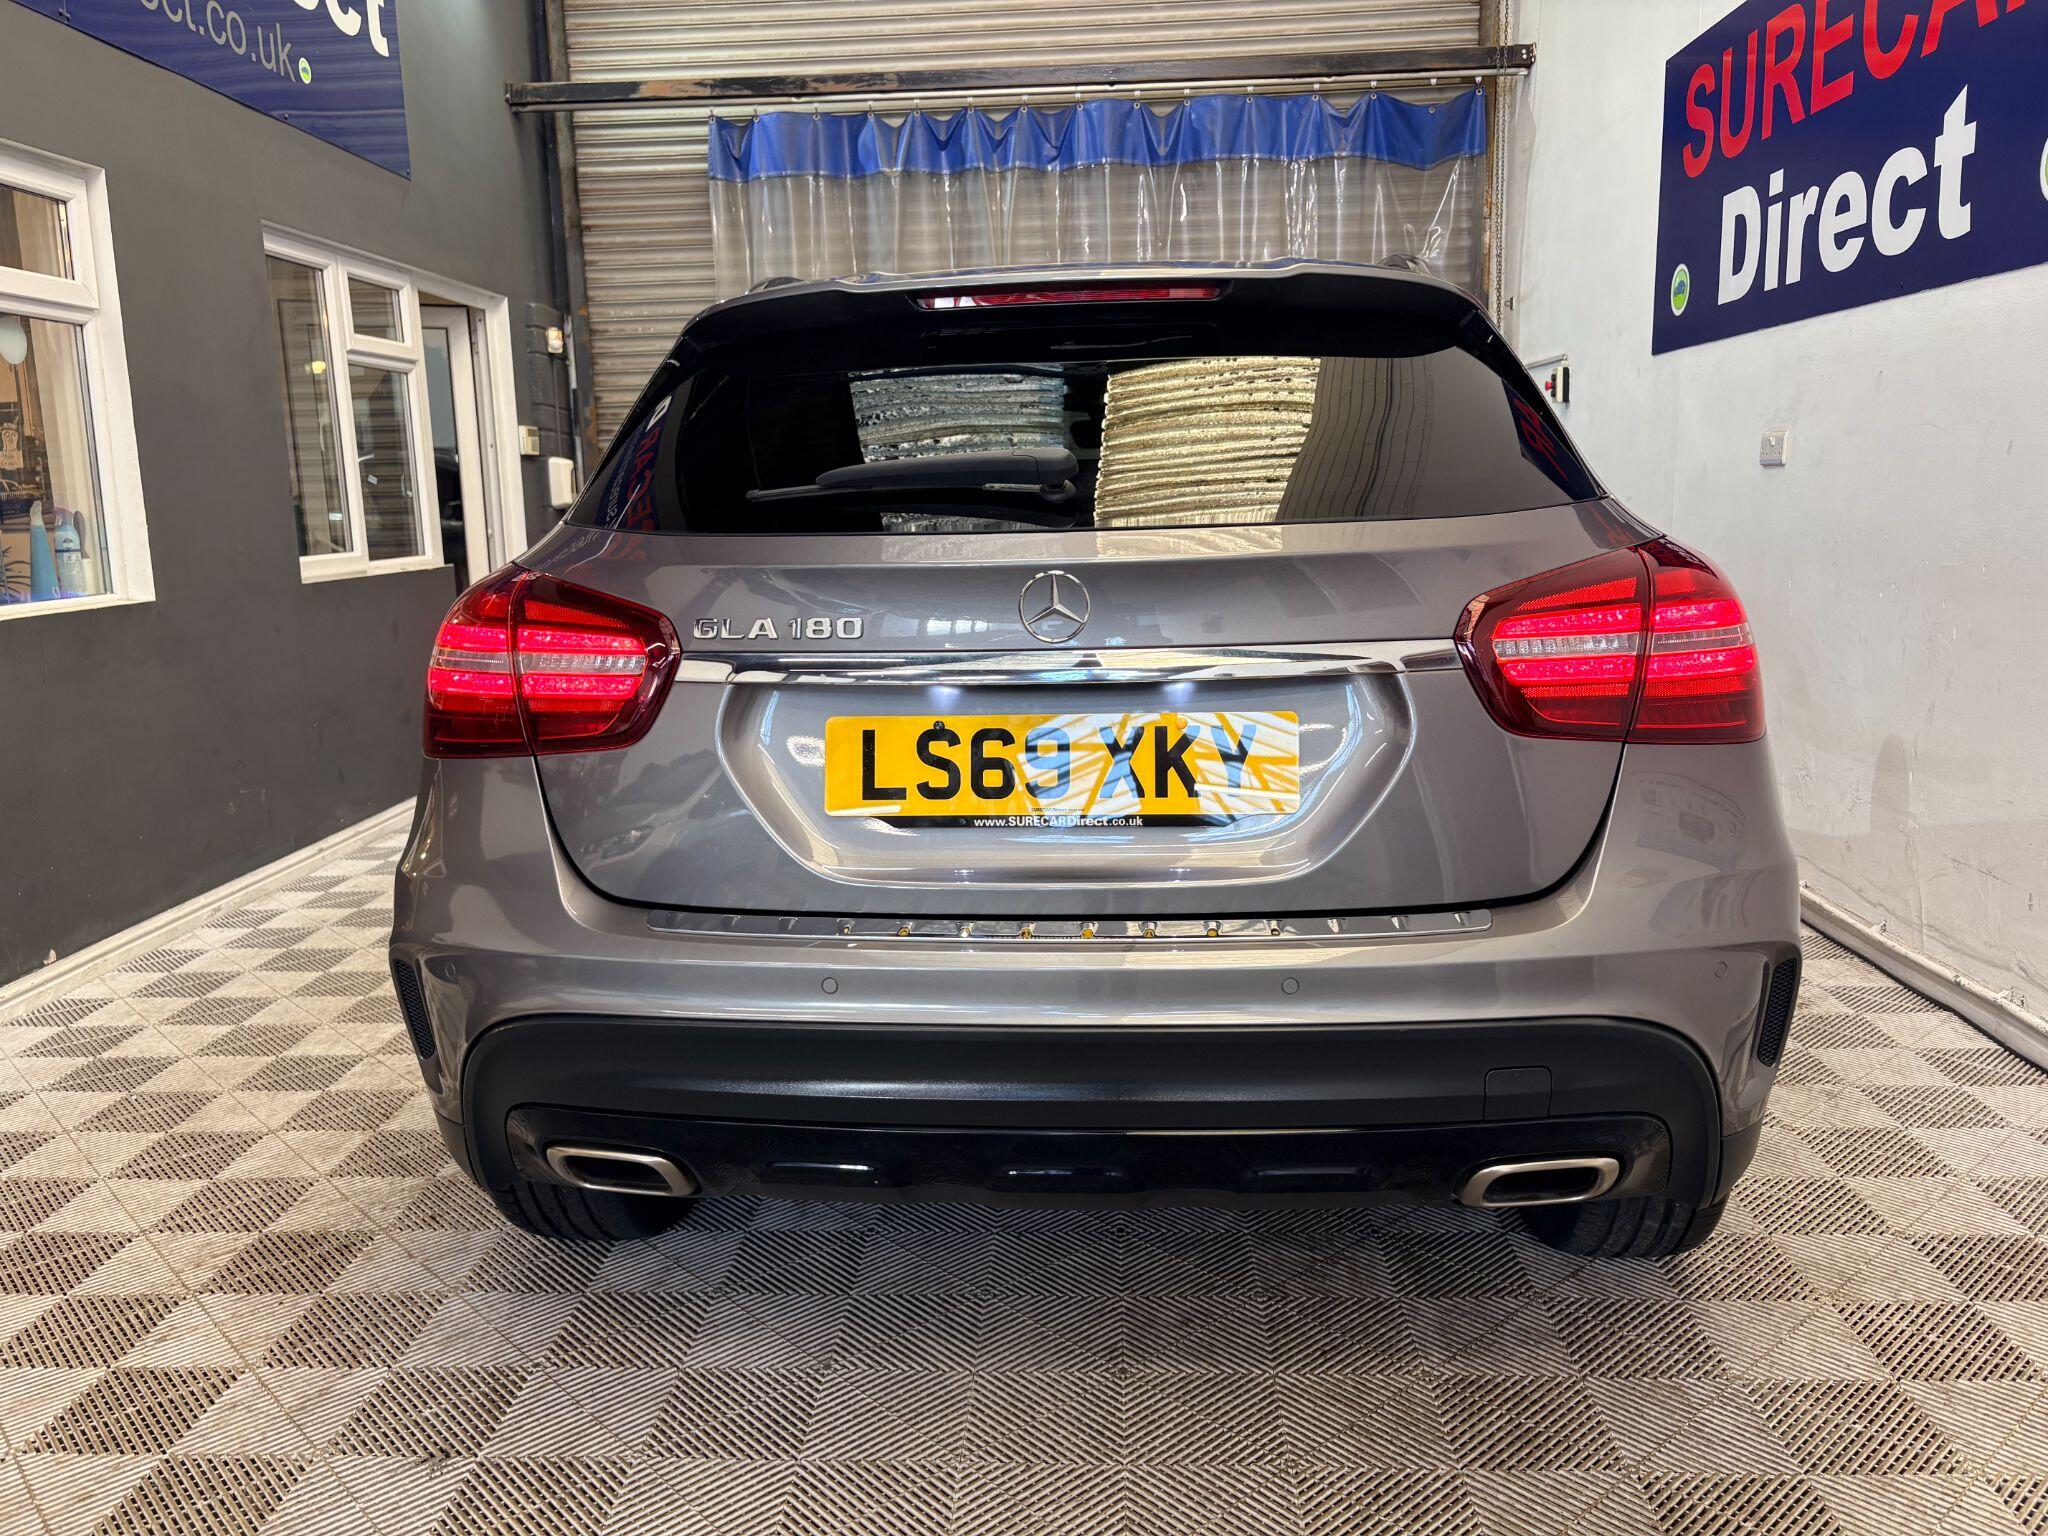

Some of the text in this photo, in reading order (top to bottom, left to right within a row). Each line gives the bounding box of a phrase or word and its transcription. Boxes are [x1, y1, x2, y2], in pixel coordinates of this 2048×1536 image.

[1718, 84, 1977, 306] Direct
[693, 617, 864, 640] GLA 180
[861, 724, 1257, 801] LS69 XKY
[973, 815, 1143, 828] www.SURECARDirect.co.uk
